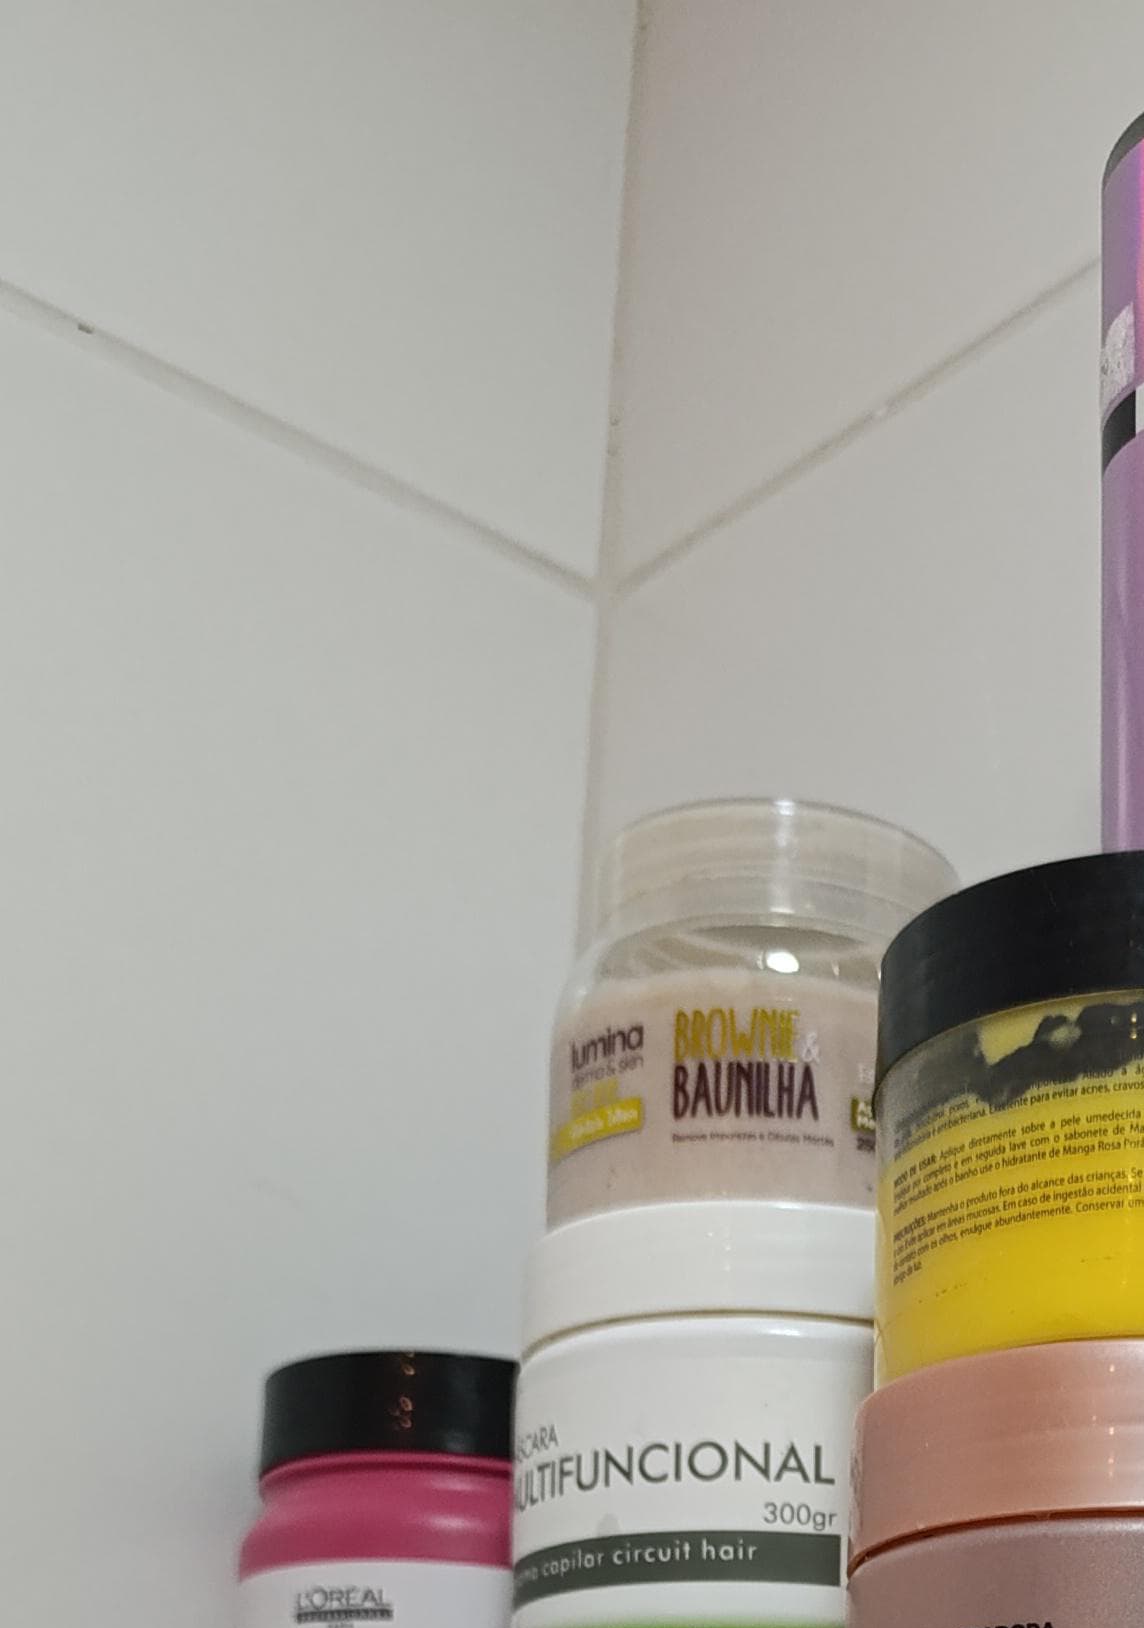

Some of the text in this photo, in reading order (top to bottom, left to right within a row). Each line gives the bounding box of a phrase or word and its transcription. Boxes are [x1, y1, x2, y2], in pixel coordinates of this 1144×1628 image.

[674, 1061, 818, 1120] BAUNILHA
[1030, 1093, 1050, 1106] para
[1113, 1082, 1144, 1092] cravos
[969, 1129, 1016, 1149] diretamente
[1021, 1123, 1045, 1134] sobre
[976, 1146, 1006, 1163] seguida
[1030, 1137, 1049, 1147] com
[1002, 1142, 1095, 1169] hidratante Manga
[1031, 1176, 1064, 1191] alcance
[1096, 1183, 1141, 1195] acidental
[515, 1439, 835, 1512] ULTIFUNCIONAL
[763, 1502, 837, 1531] 300gr
[542, 1539, 757, 1577] capilar circuit hair
